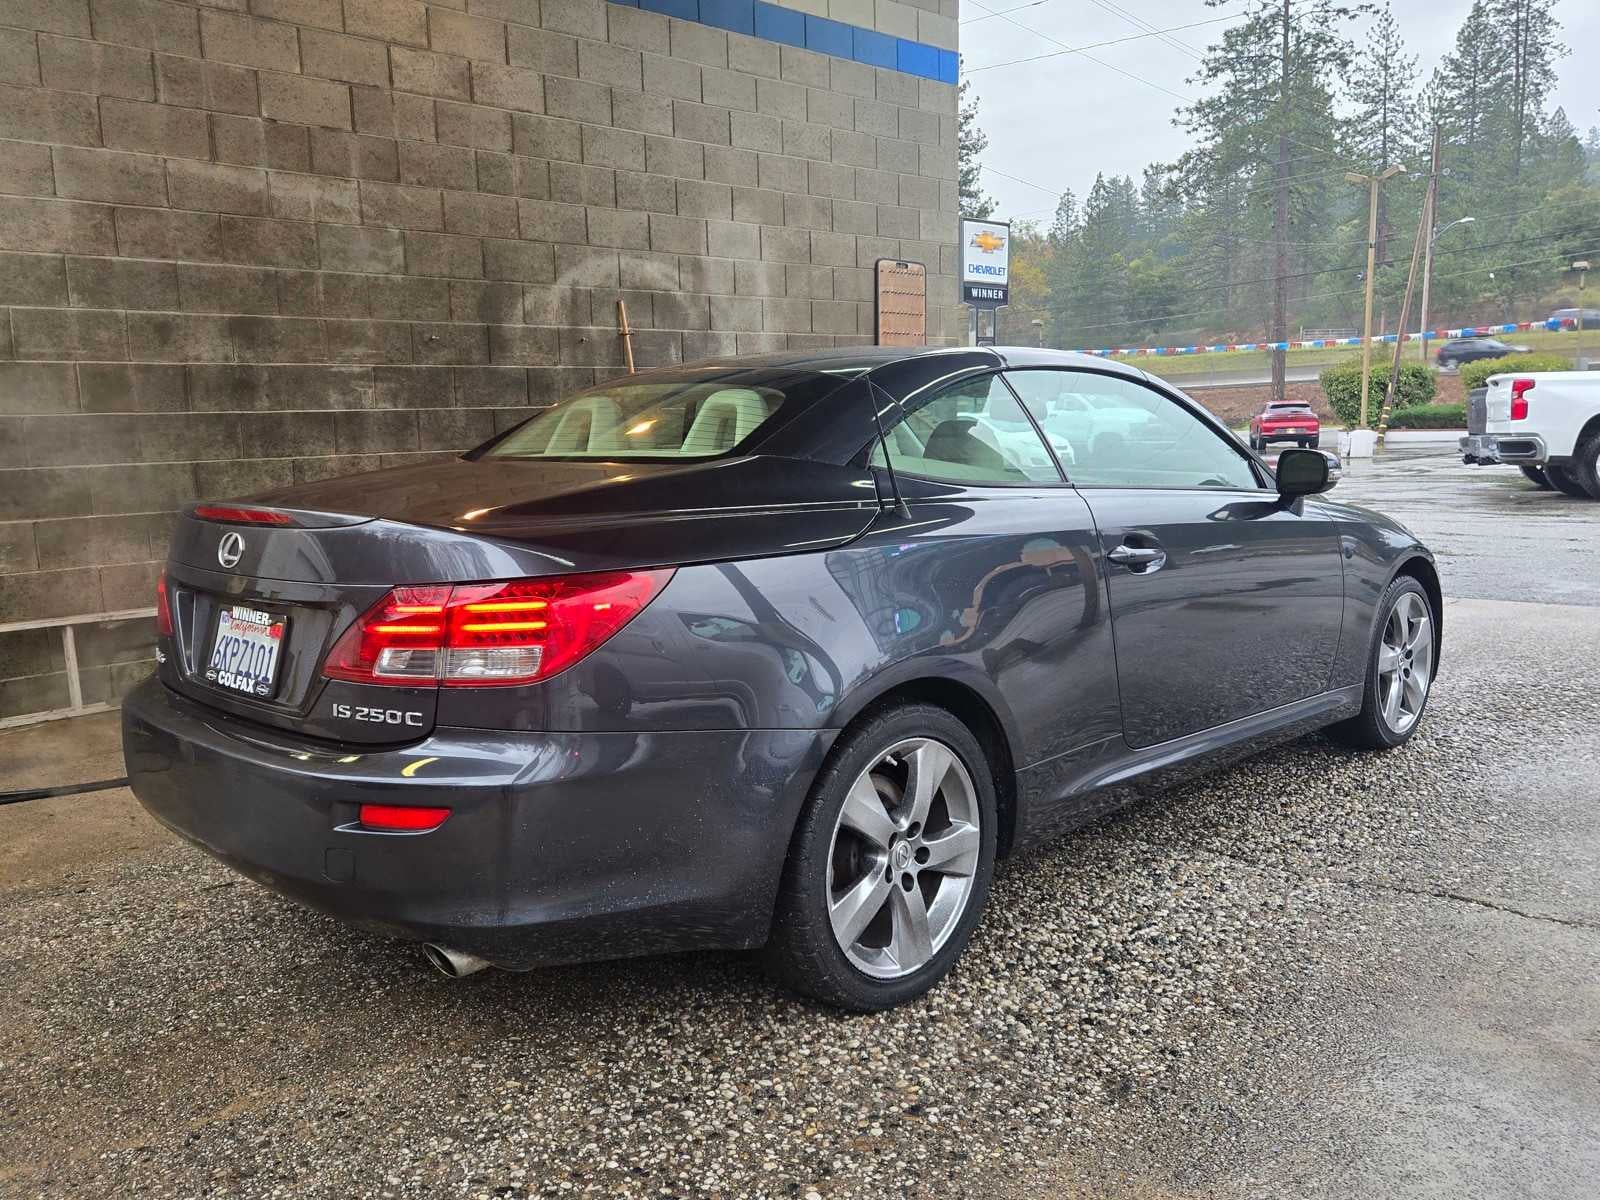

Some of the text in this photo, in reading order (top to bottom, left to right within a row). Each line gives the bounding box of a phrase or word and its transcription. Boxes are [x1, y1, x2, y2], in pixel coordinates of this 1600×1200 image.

[968, 263, 1006, 276] CHEVROLET
[971, 287, 1004, 299] WINNER
[232, 606, 270, 626] WINNER
[212, 634, 274, 682] 6KPZ101
[217, 670, 256, 693] COLFAX
[332, 703, 352, 719] IS
